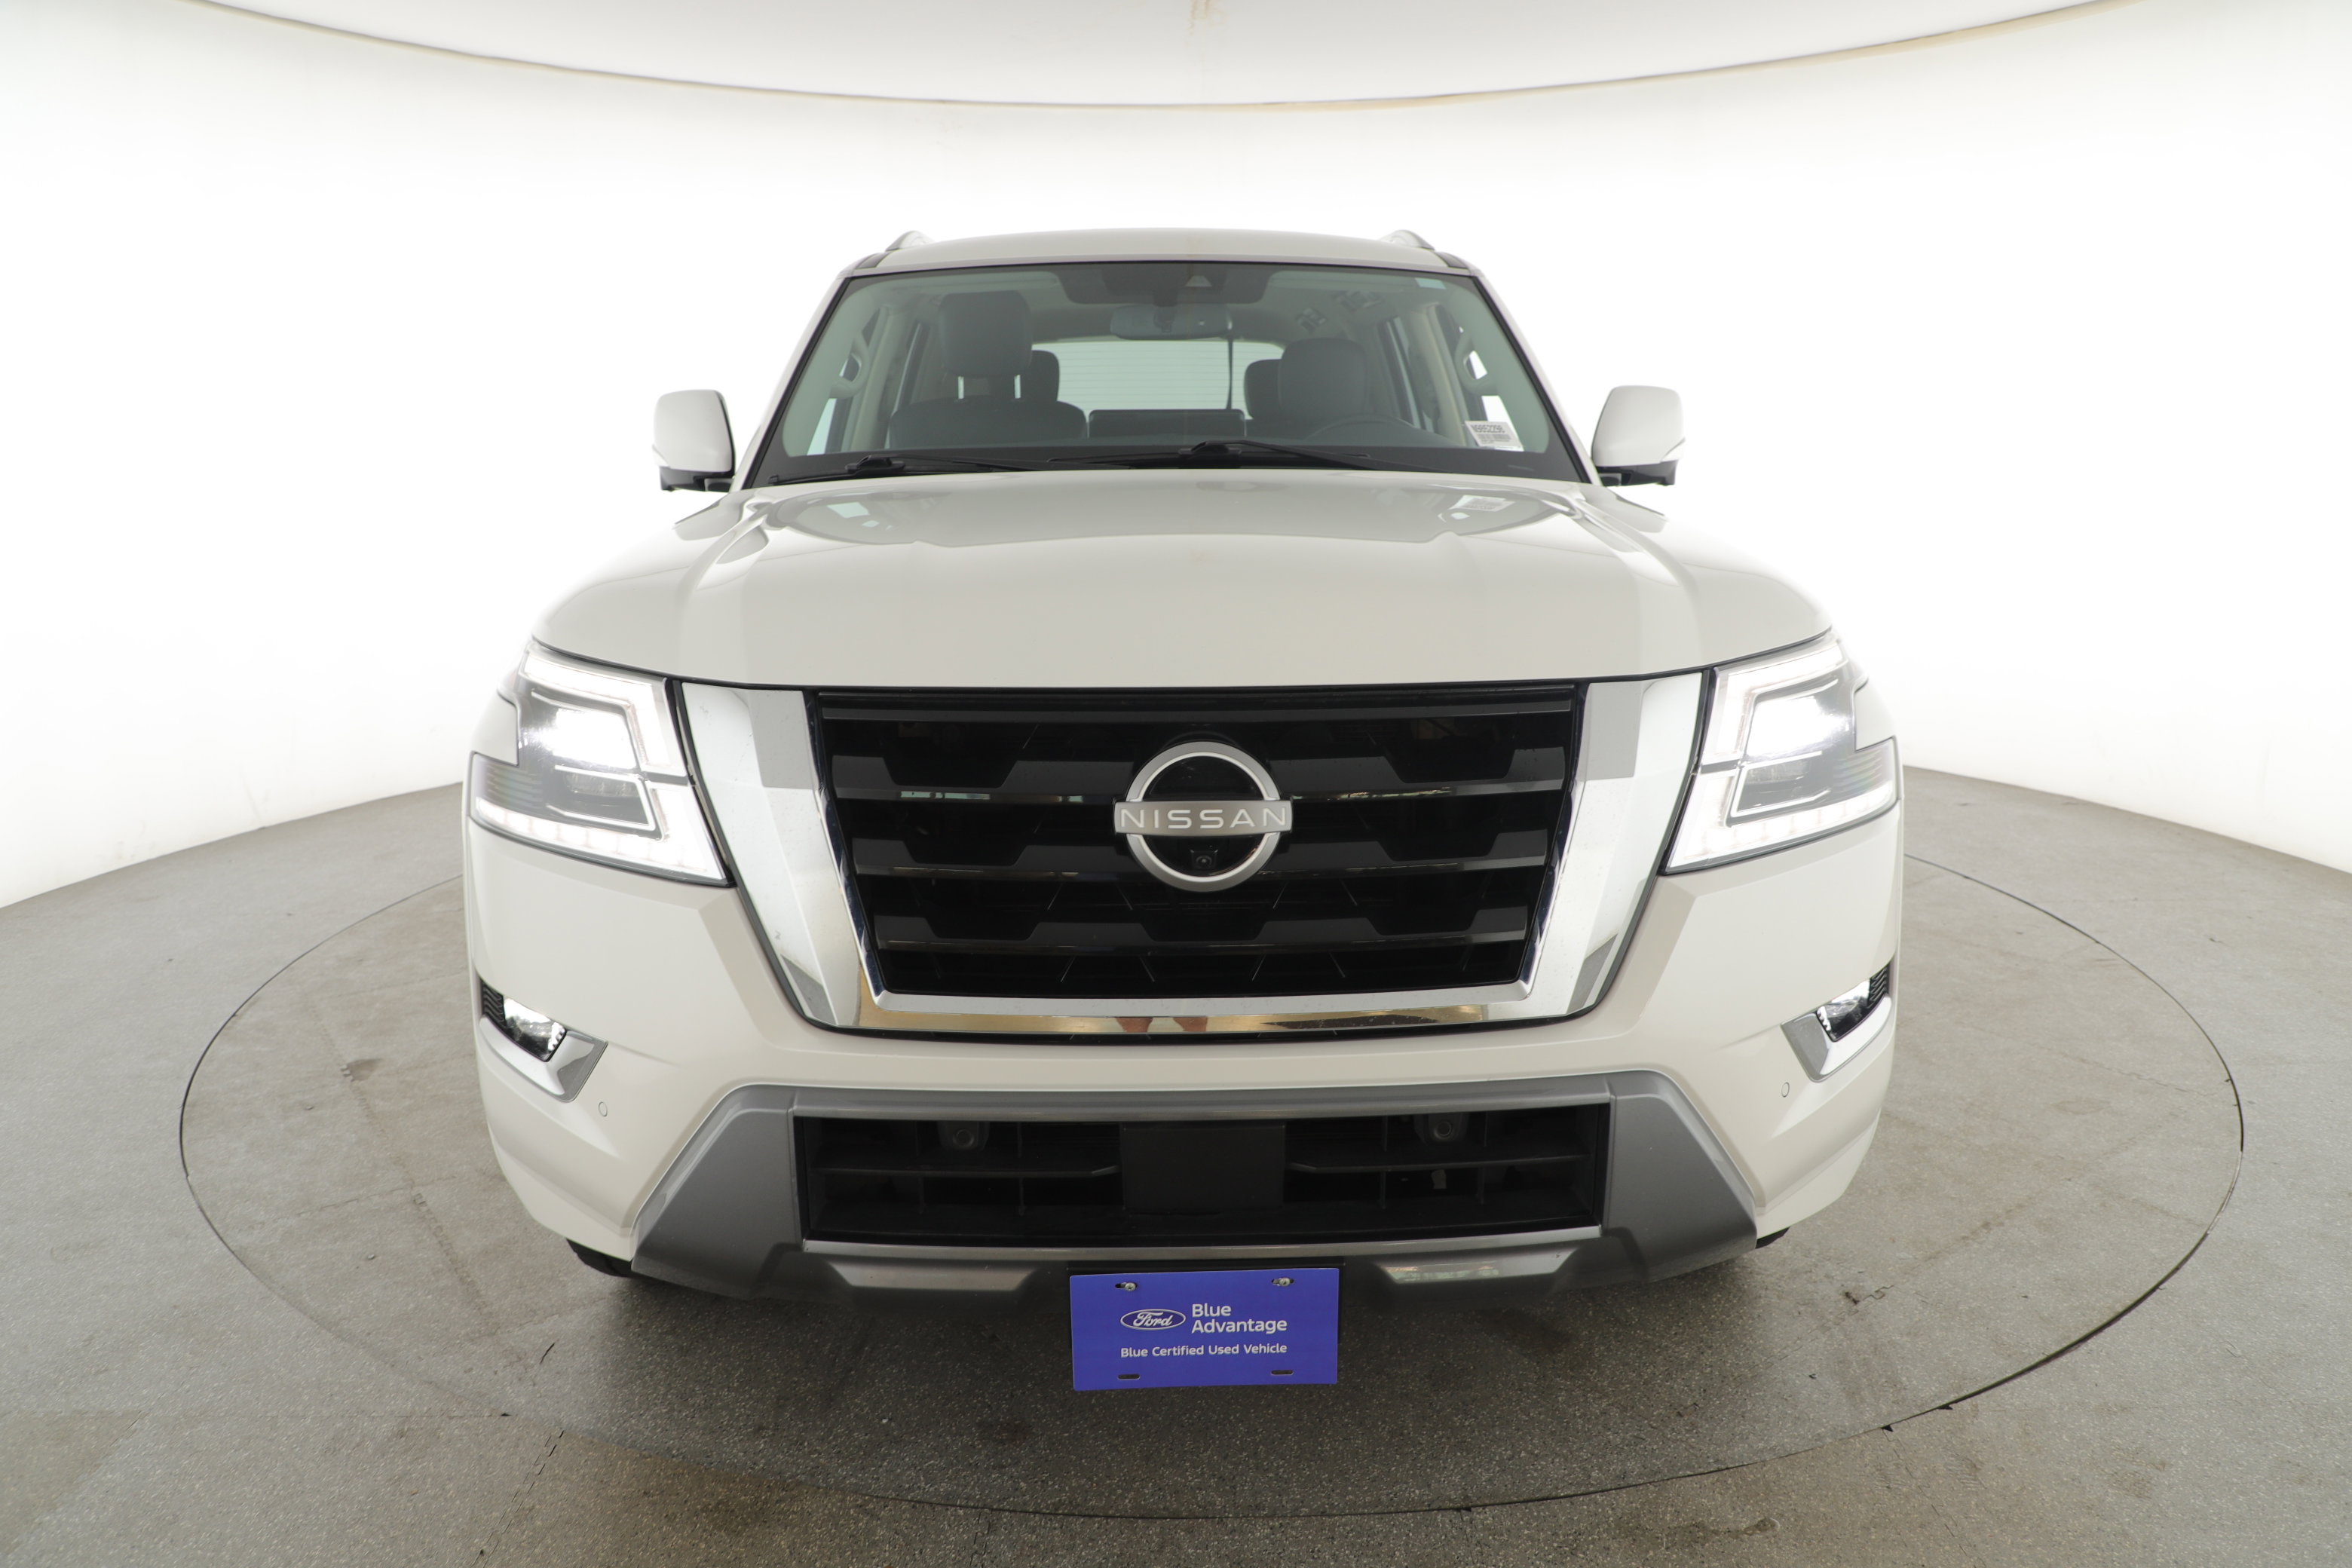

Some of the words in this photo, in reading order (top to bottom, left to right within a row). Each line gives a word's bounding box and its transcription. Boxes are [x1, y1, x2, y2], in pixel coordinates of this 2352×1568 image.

[1121, 808, 1286, 829] NISSAN
[1192, 1303, 1232, 1318] Blue
[1132, 1311, 1173, 1328] Ford
[1191, 1318, 1288, 1334] Advantage
[1120, 1347, 1148, 1358] Blue
[1152, 1345, 1205, 1356] Certified
[1208, 1343, 1239, 1355] Used
[1244, 1343, 1288, 1354] Vehicle
